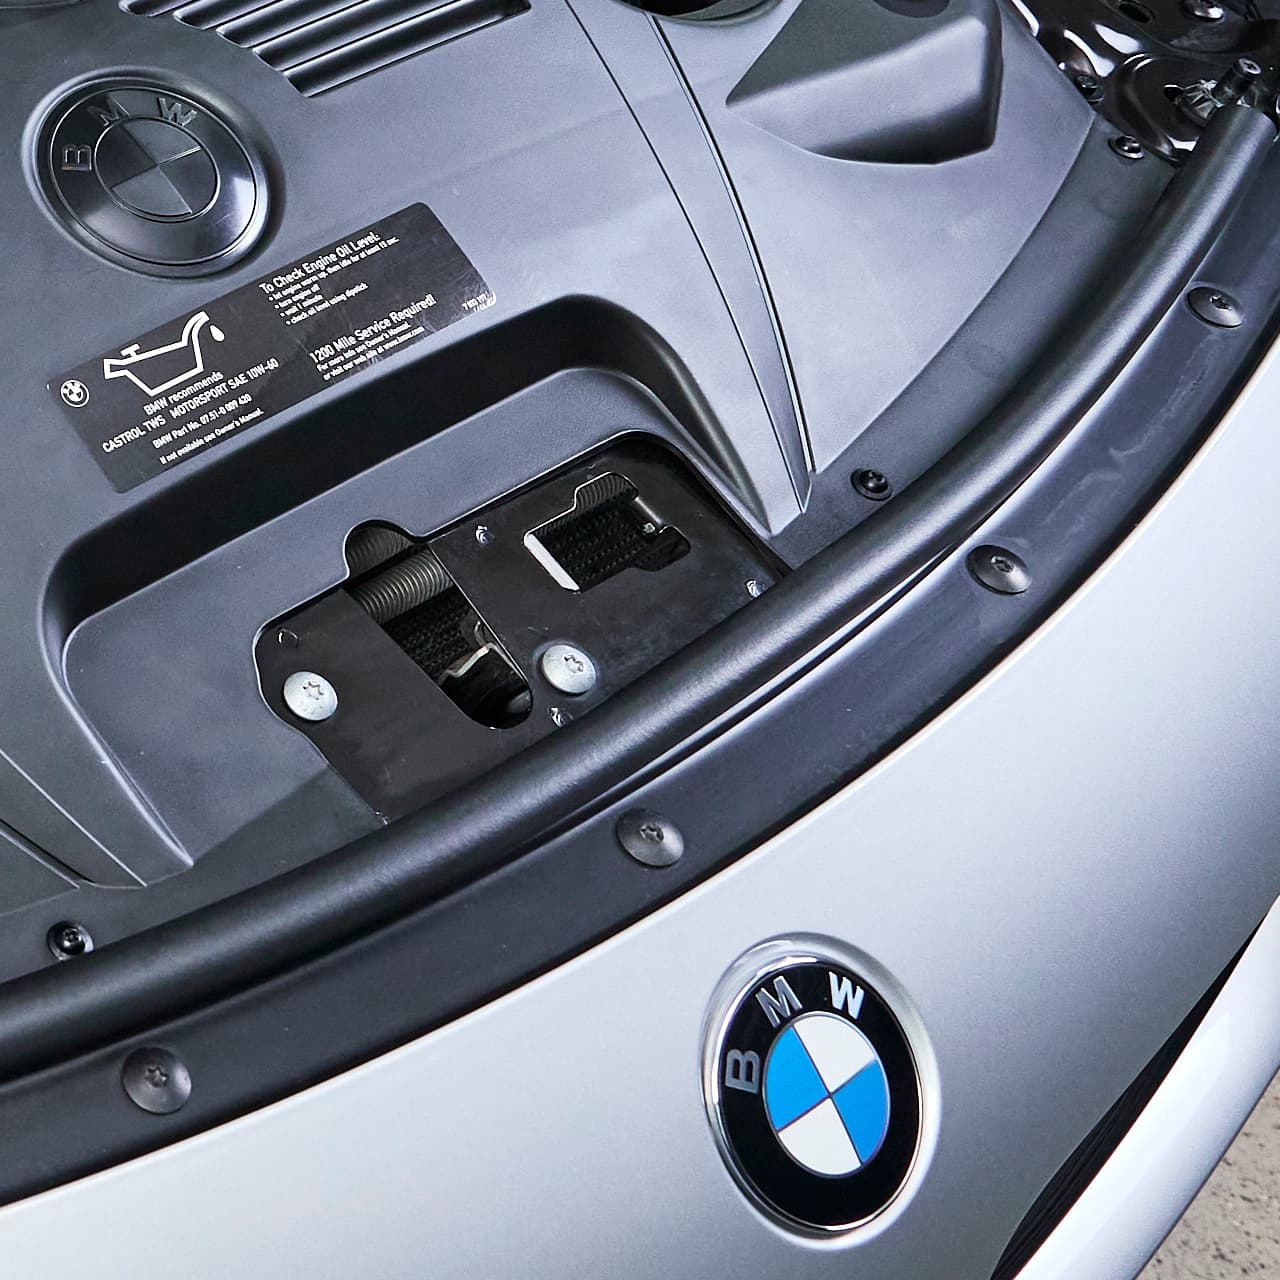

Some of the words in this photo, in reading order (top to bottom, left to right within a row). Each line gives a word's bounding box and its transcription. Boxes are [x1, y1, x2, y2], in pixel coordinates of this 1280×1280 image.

[61, 96, 198, 172] BMW
[258, 282, 275, 294] To
[272, 267, 306, 288] Check
[301, 253, 338, 274] Engine
[335, 244, 353, 257] Oil
[348, 231, 381, 251] Level:
[309, 344, 335, 363] 1200
[332, 336, 357, 352] Mile
[354, 318, 392, 341] Service
[388, 293, 437, 324] Required!
[143, 396, 168, 415] BMW
[167, 371, 224, 404] recommends
[316, 362, 329, 372] For
[102, 426, 146, 452] CASTROL
[142, 414, 166, 431] TWS
[169, 382, 229, 419] MOTORSPORT
[227, 373, 249, 389] SAE
[246, 357, 279, 379] 10W-60
[152, 432, 173, 448] BMW
[171, 425, 189, 439] Part
[186, 421, 202, 431] No.
[725, 972, 864, 1094] BMW
